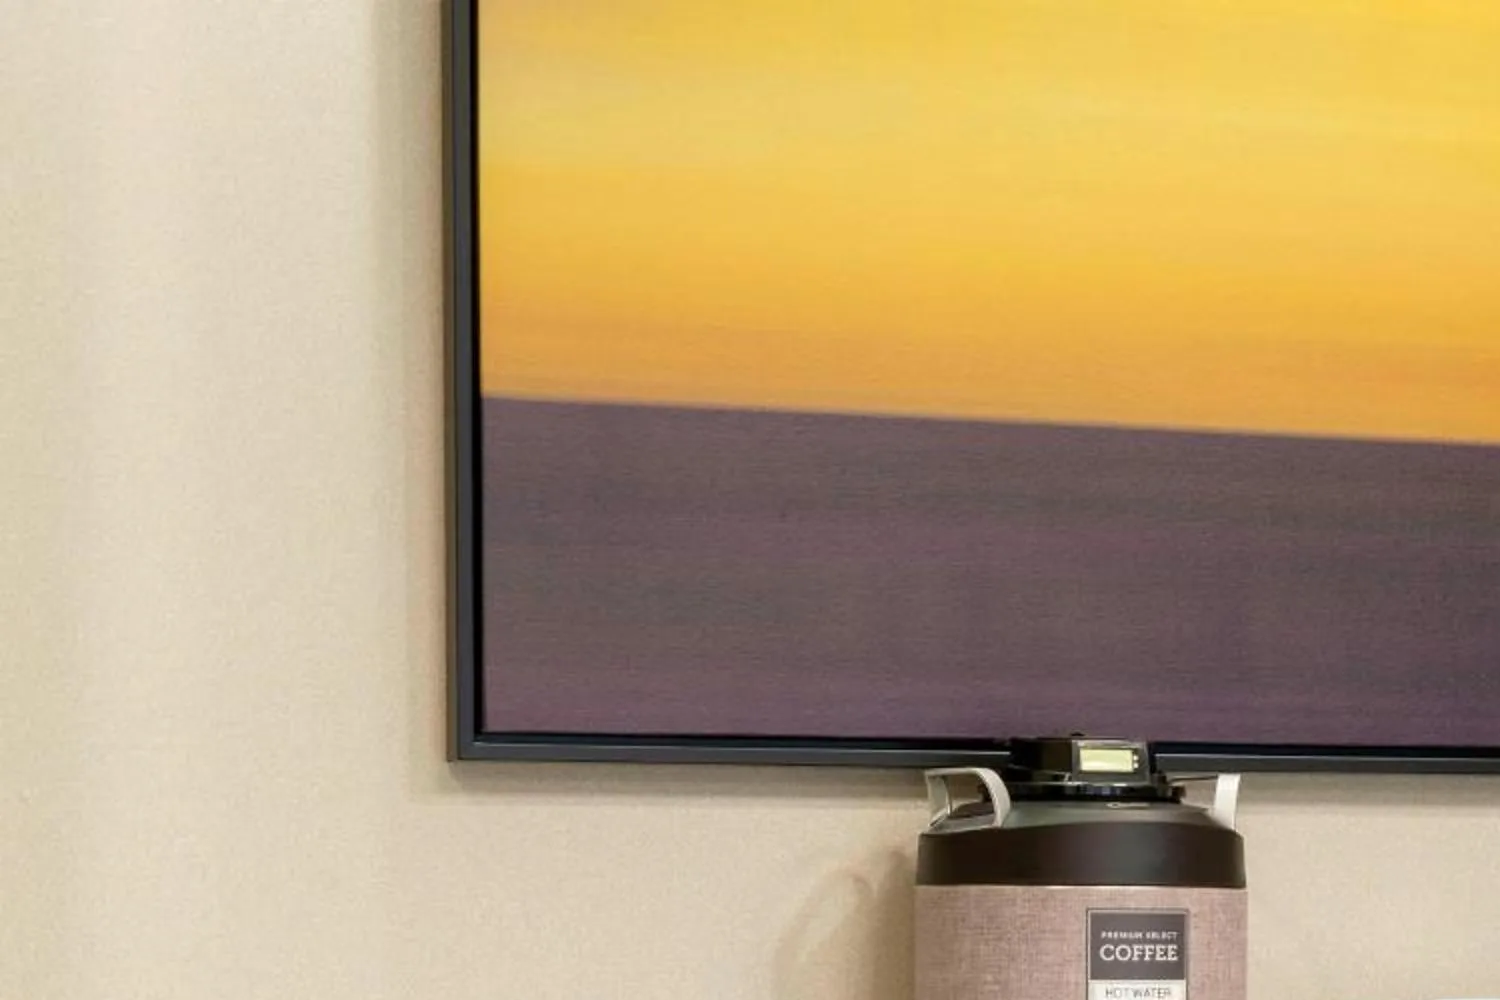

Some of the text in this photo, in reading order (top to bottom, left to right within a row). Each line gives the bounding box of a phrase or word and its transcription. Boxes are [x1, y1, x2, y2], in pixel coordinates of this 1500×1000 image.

[1100, 944, 1179, 961] COFFEE
[1105, 987, 1172, 998] HOT WATER
